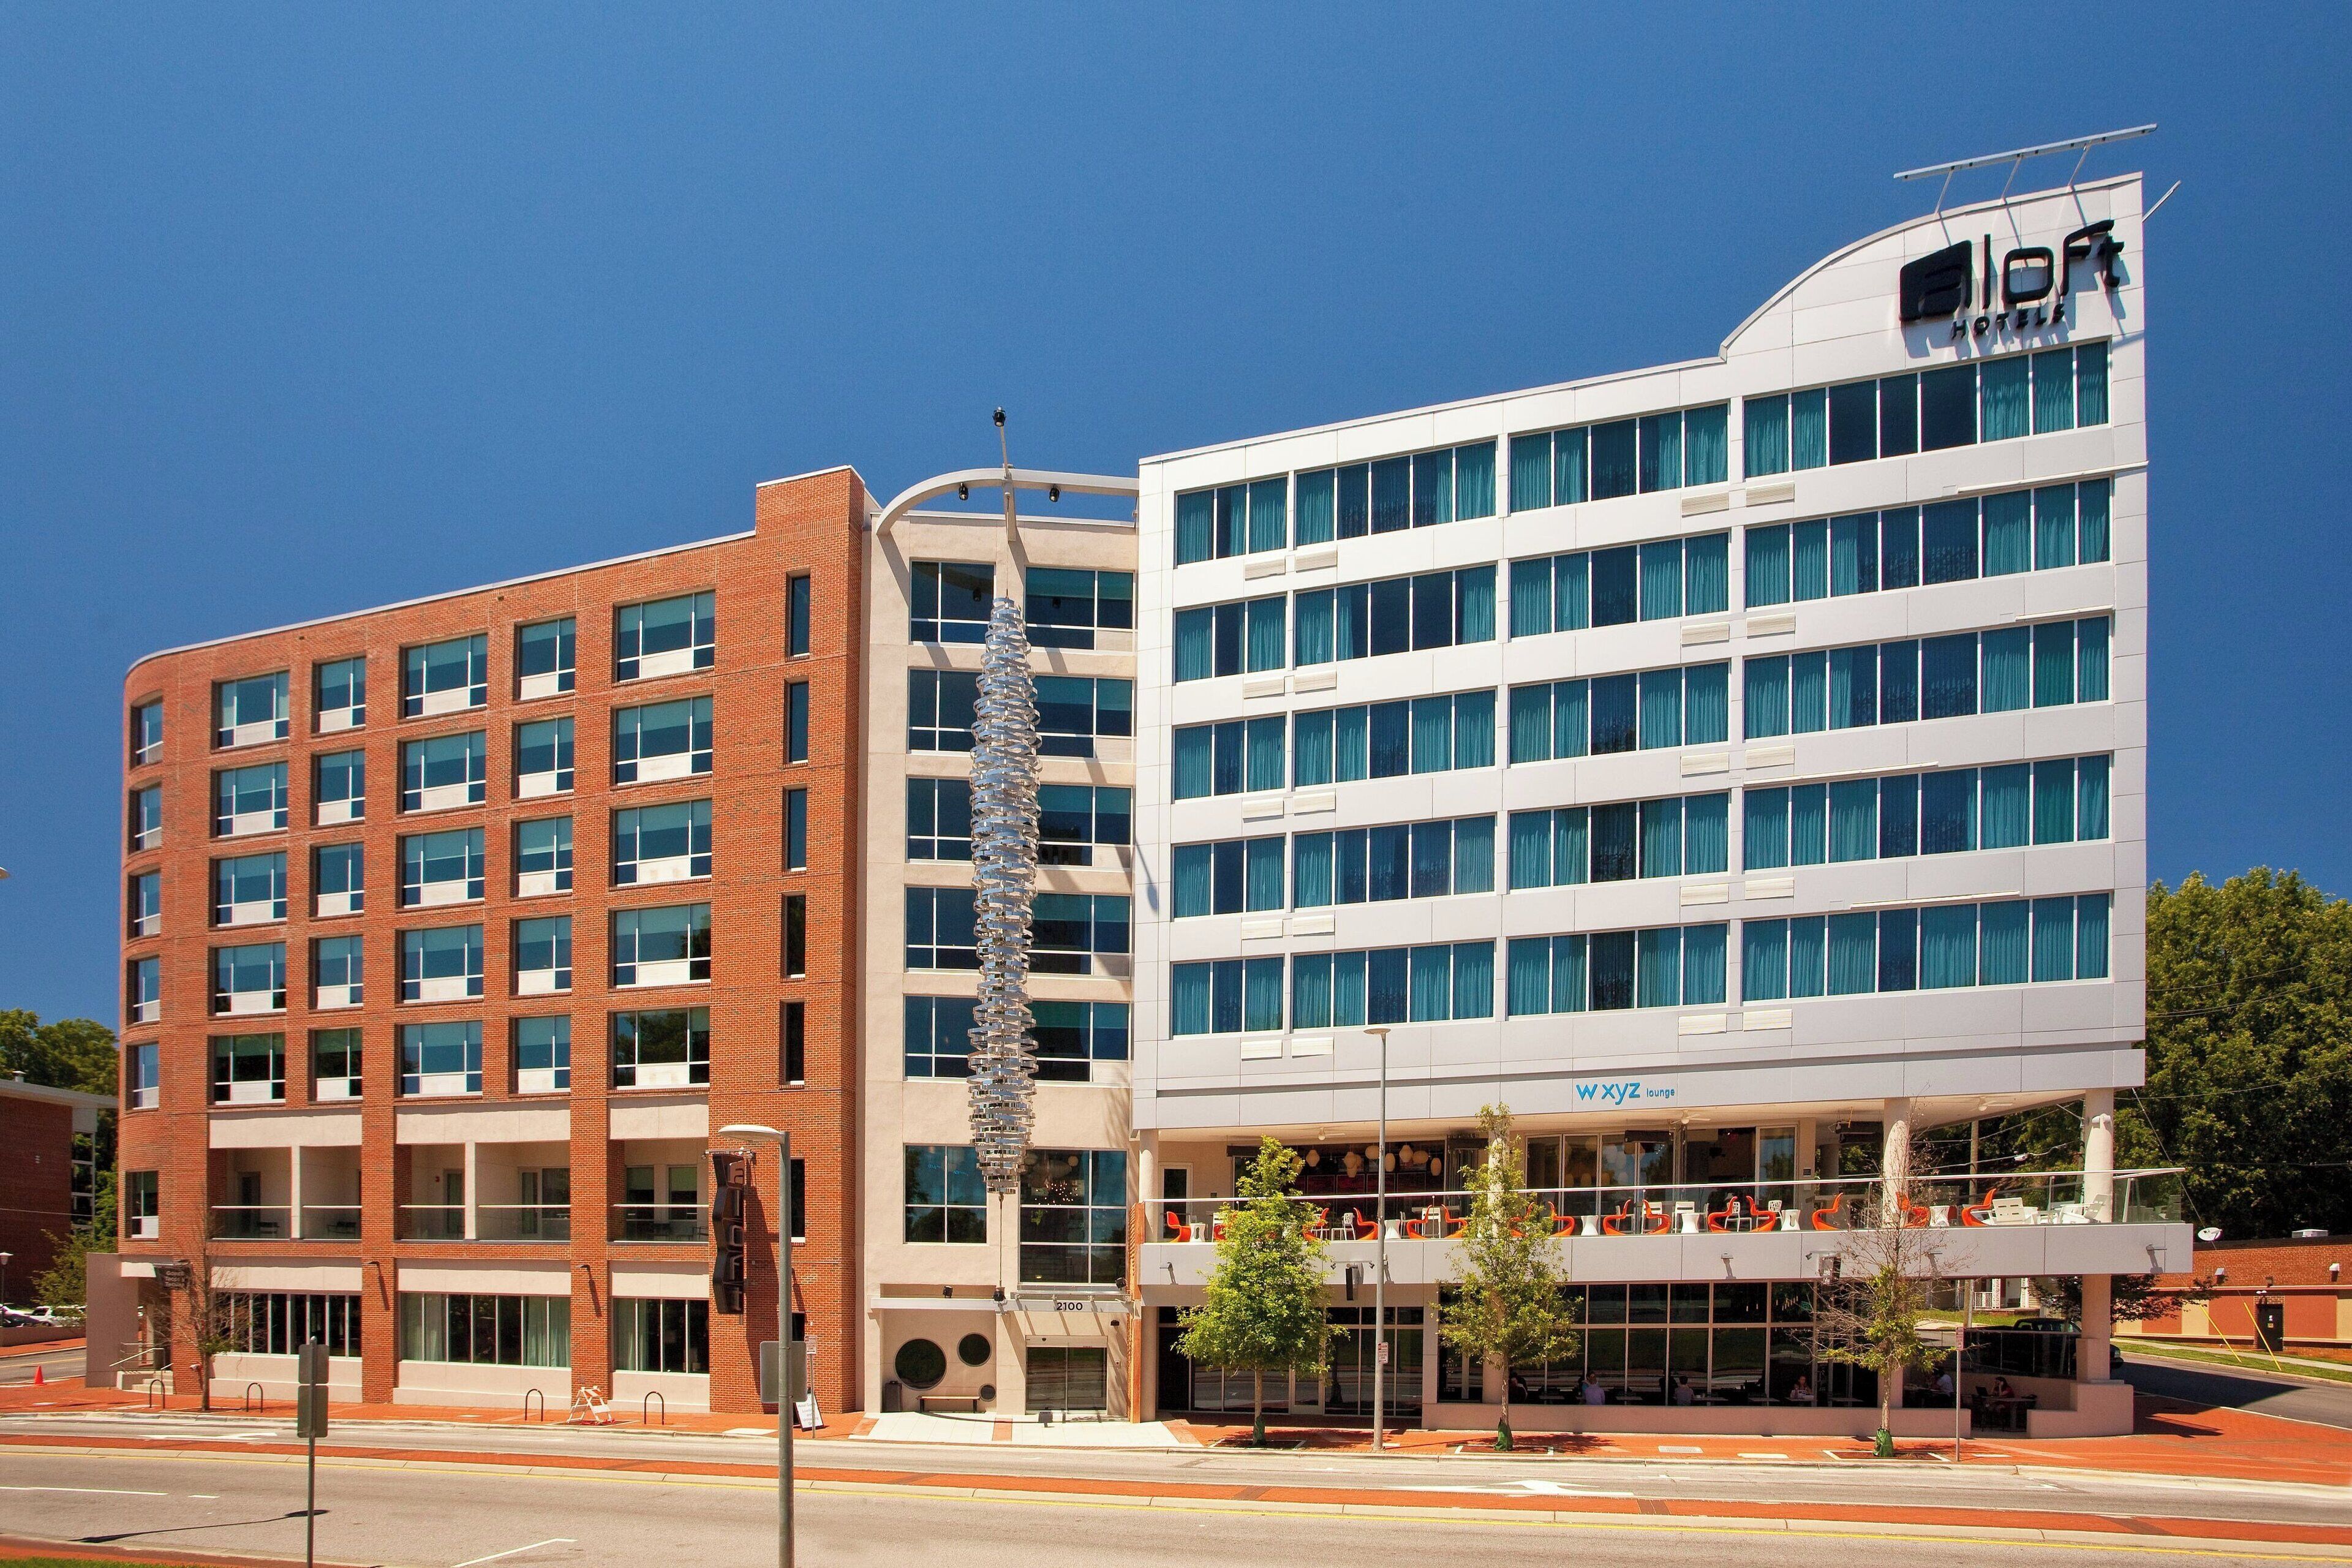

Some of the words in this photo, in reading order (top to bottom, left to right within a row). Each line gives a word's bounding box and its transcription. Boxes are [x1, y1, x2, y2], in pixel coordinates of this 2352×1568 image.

[1899, 219, 2125, 322] aloft
[1951, 303, 2065, 340] HOTELS
[1646, 1087, 1675, 1099] lounge
